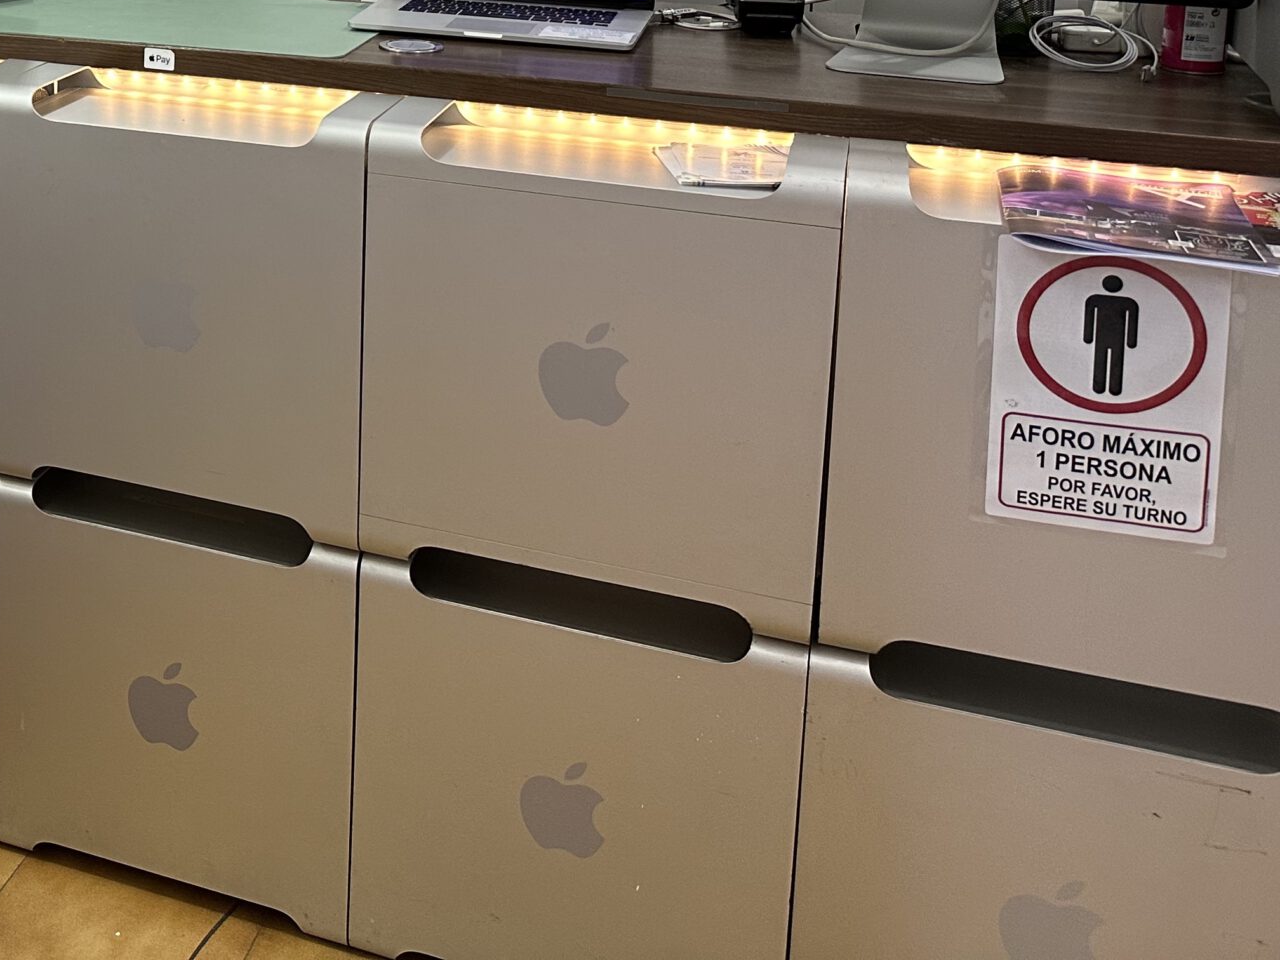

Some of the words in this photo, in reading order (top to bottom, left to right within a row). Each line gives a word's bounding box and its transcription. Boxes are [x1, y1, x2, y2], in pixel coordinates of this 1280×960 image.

[156, 54, 170, 65] Pay
[1010, 423, 1094, 450] AFORO
[1102, 432, 1201, 462] MÁXIMO
[1036, 451, 1045, 468] 1
[1055, 453, 1172, 484] PERSONA
[1048, 476, 1086, 494] POR
[1091, 483, 1156, 505] FAVOR,
[1016, 490, 1088, 512] ESPERE
[1092, 501, 1117, 516] SU
[1122, 504, 1188, 526] TURNO
